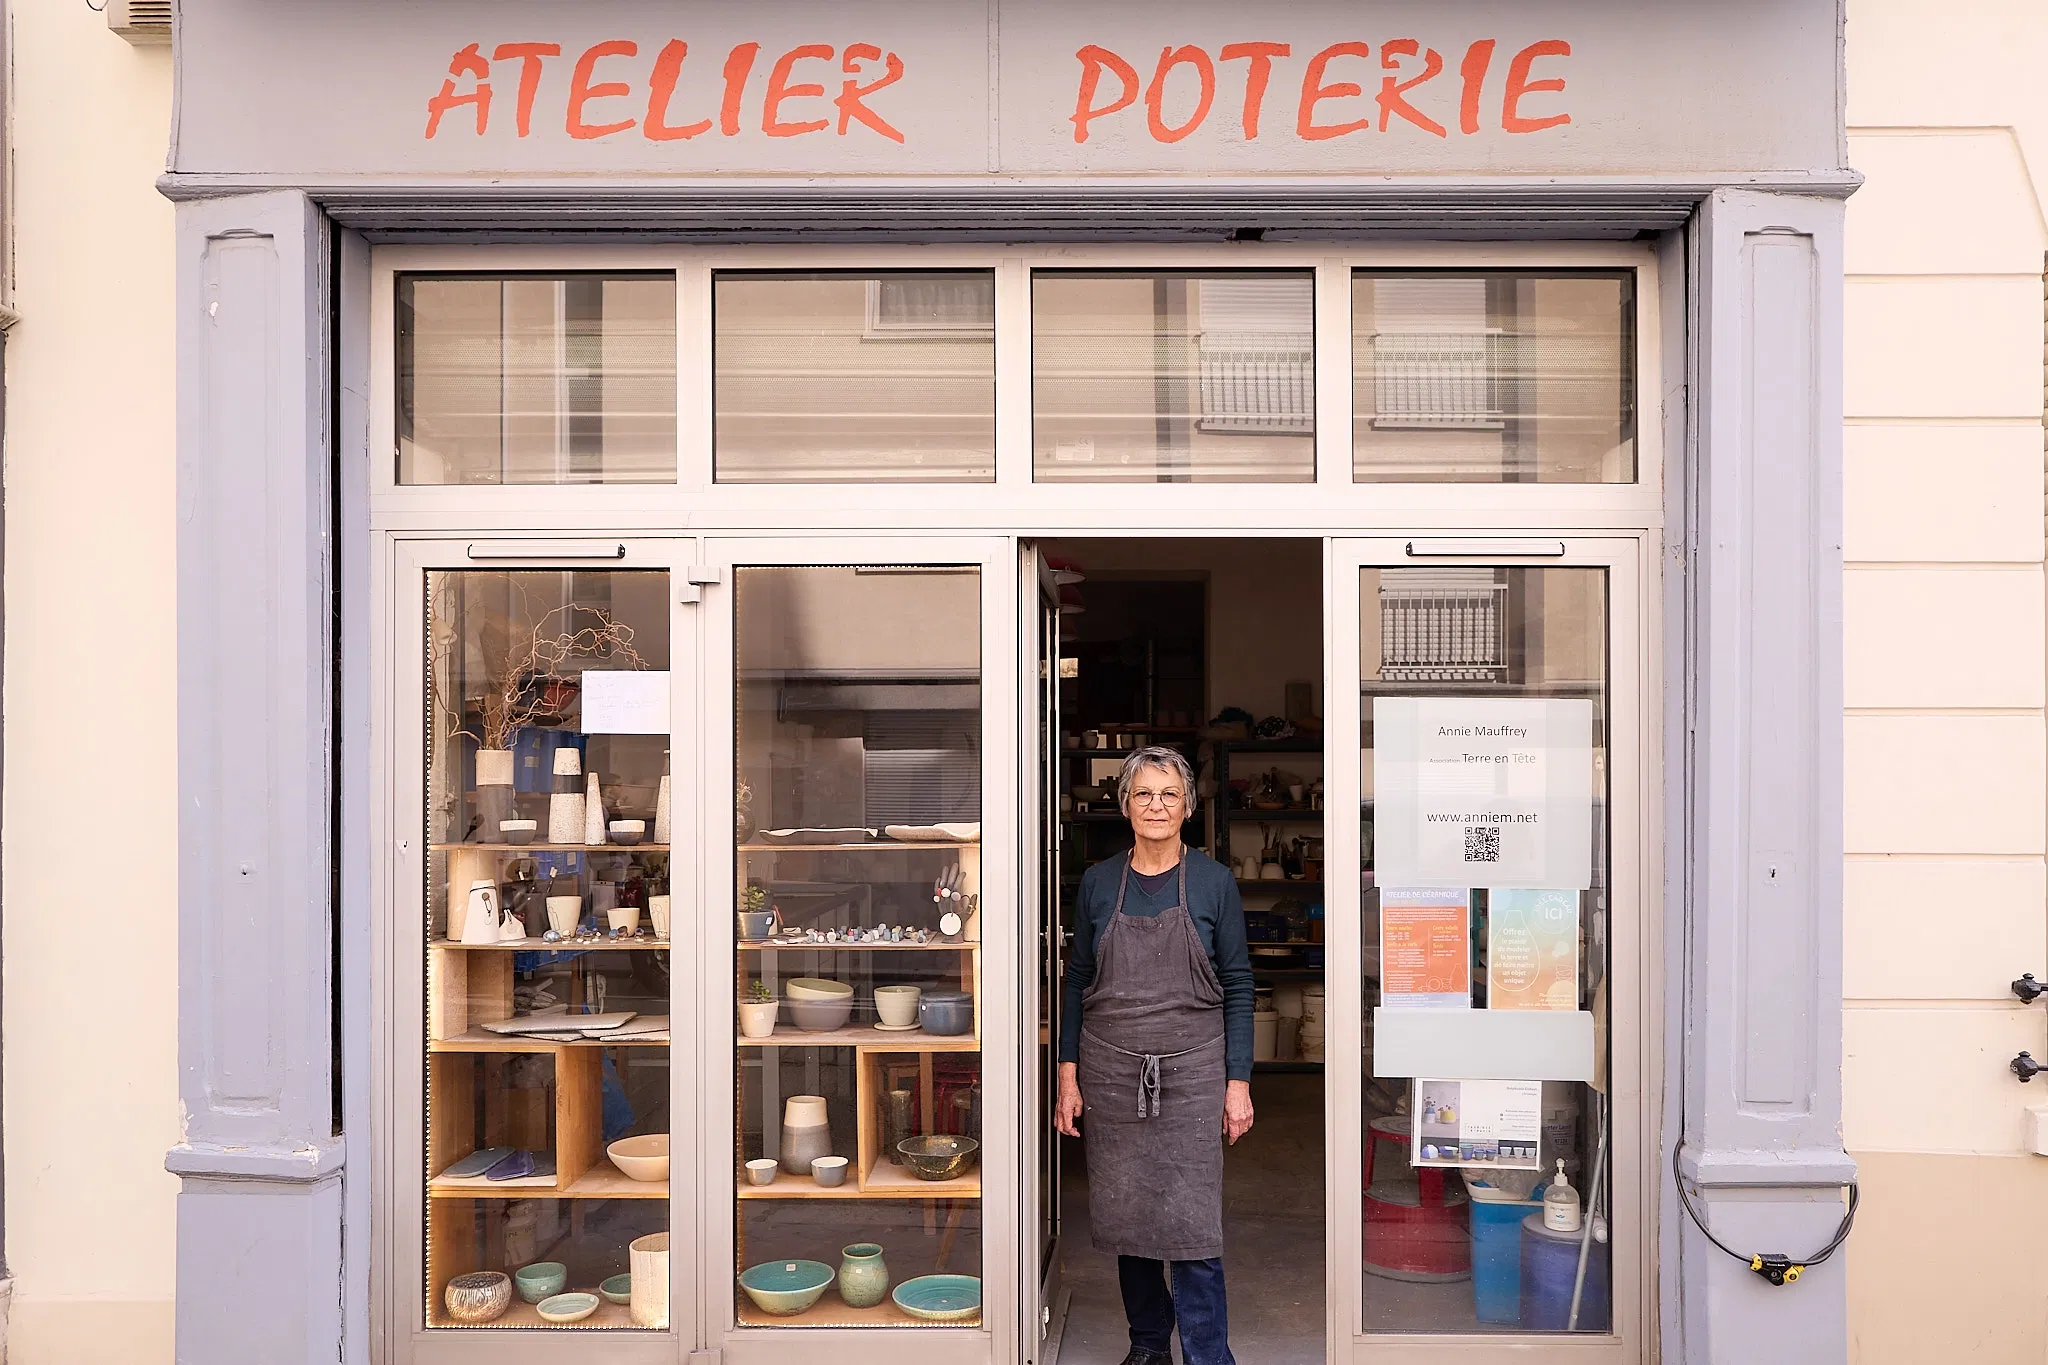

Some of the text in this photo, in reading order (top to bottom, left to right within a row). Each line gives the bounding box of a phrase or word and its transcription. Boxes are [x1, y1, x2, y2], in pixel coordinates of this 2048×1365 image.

[425, 38, 1572, 144] ATELIER POTERIE
[1438, 725, 1528, 739] Annie Mauffrey
[1462, 753, 1491, 764] Terre
[1494, 755, 1509, 764] en
[1512, 752, 1536, 764] Tête
[1427, 812, 1538, 824] www.anniem.net
[1545, 907, 1563, 921] ICI
